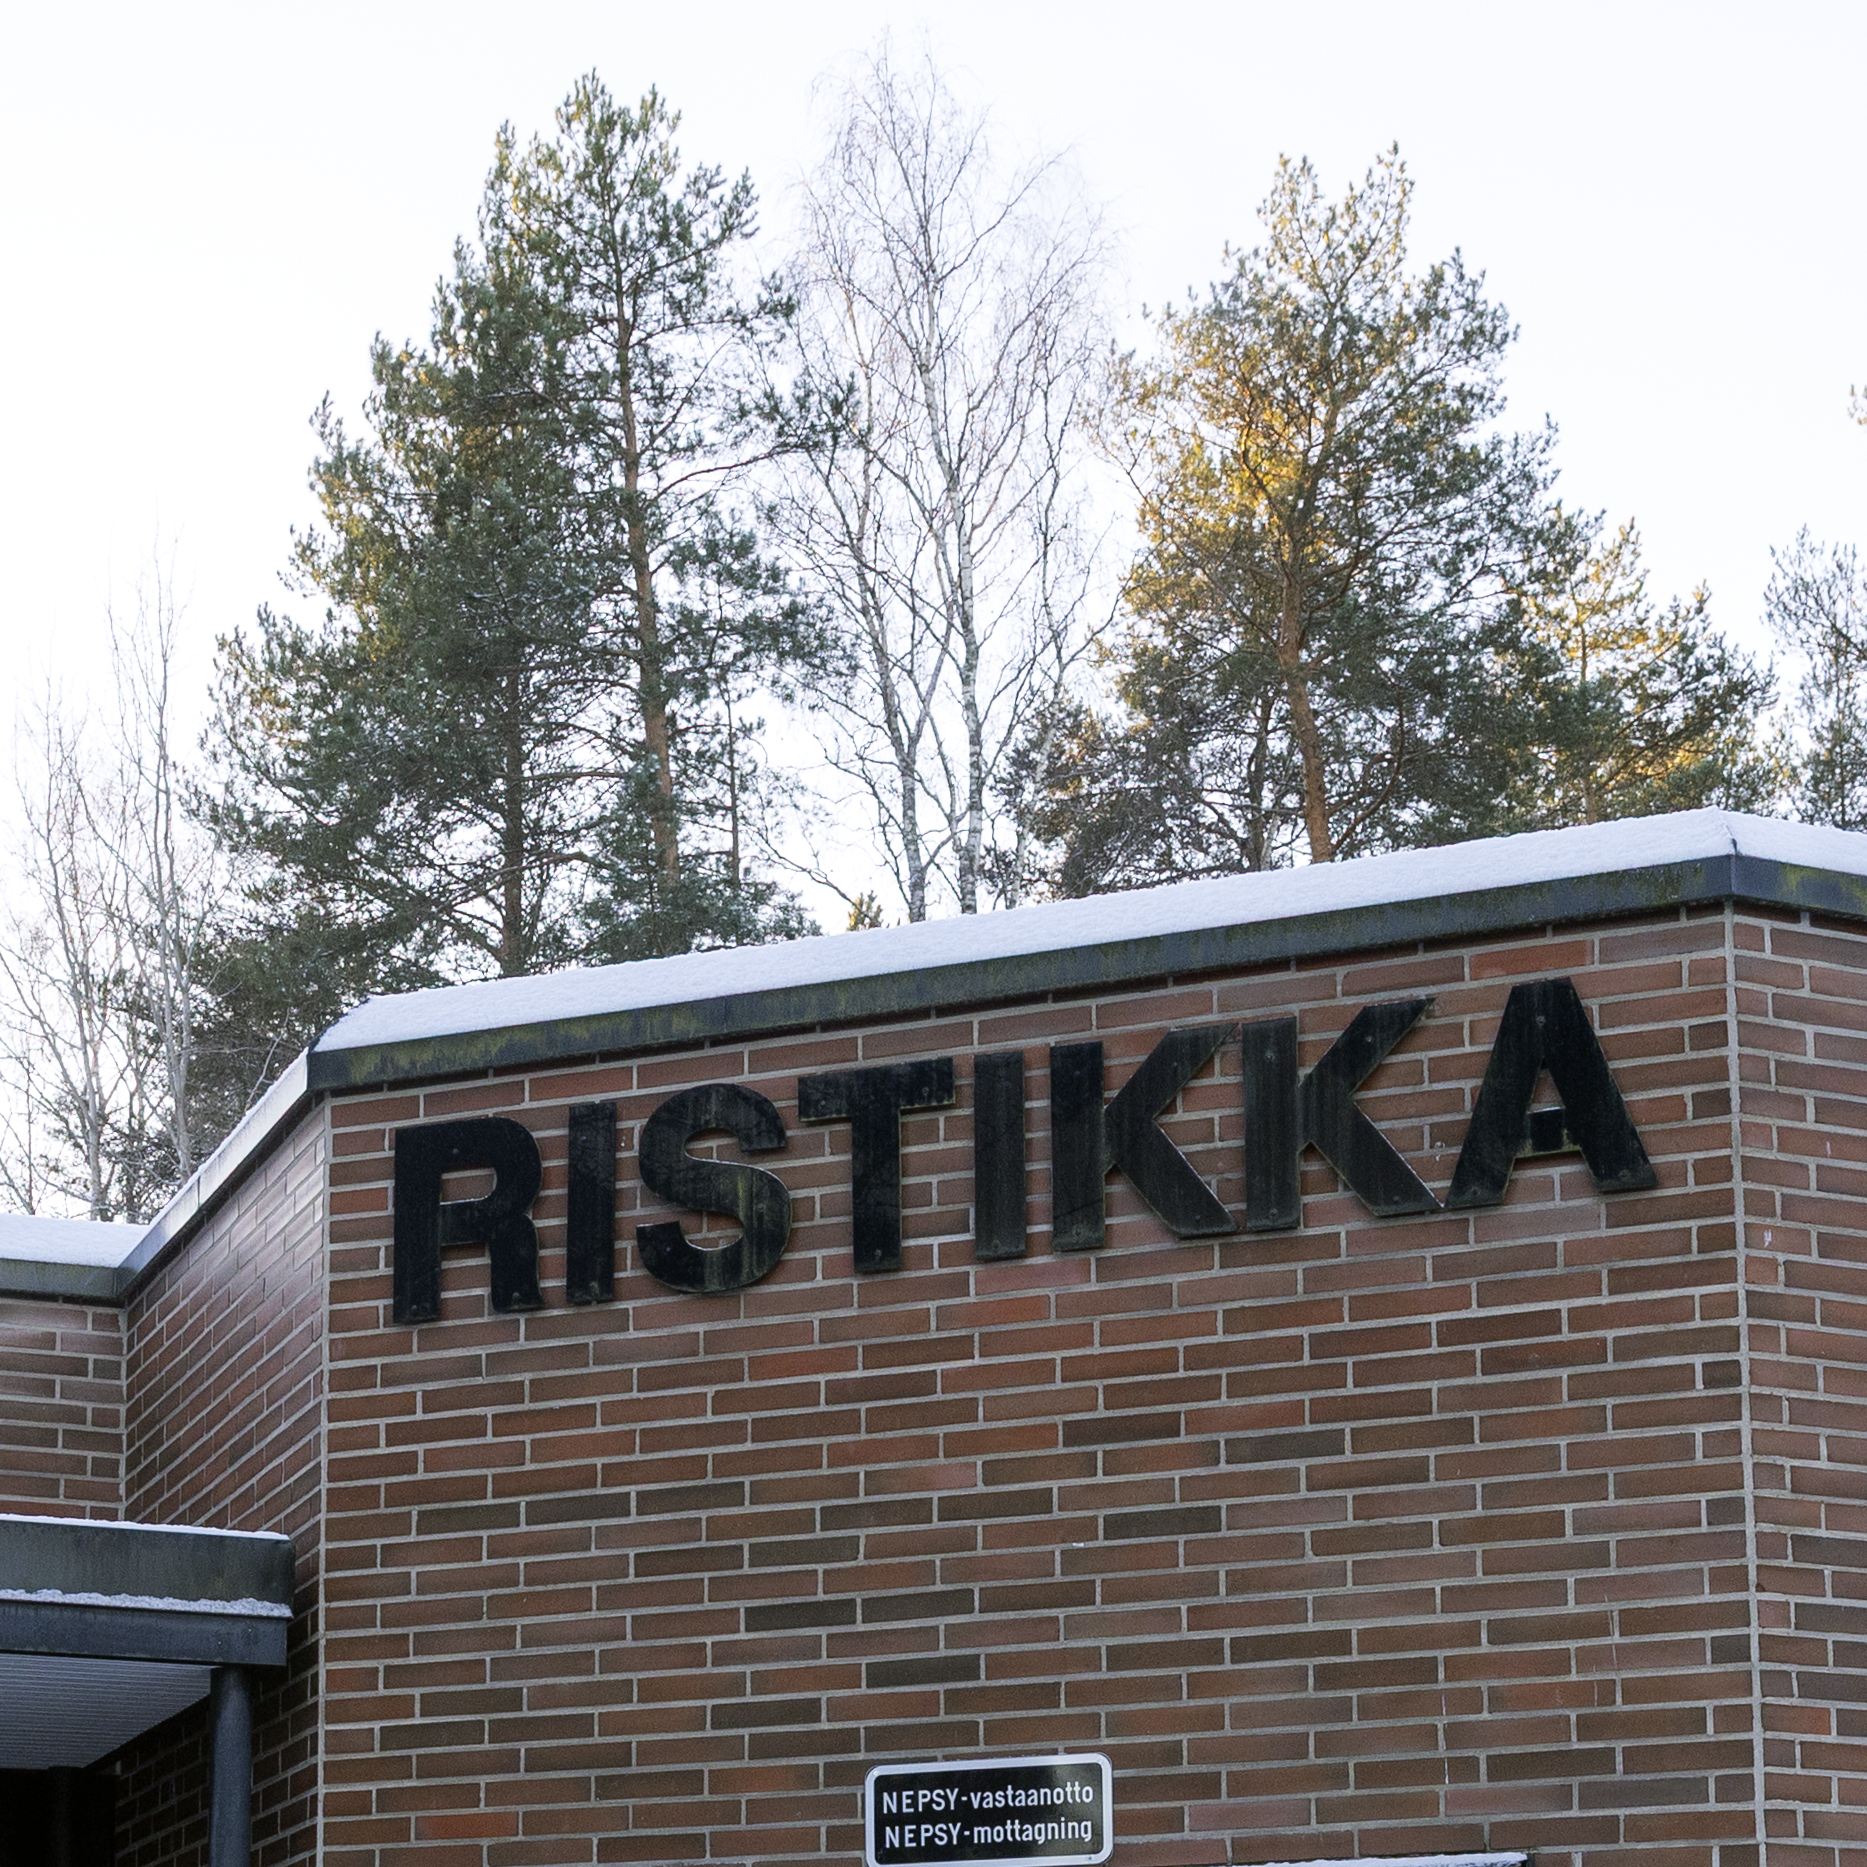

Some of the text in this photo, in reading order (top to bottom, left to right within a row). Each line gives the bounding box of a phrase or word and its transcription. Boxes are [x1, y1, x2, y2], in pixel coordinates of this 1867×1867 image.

[390, 977, 1659, 1325] RISTIKKA
[883, 1781, 1094, 1814] NEPSY-vastaanotto
[885, 1817, 1092, 1848] NEPSY-mottagning
